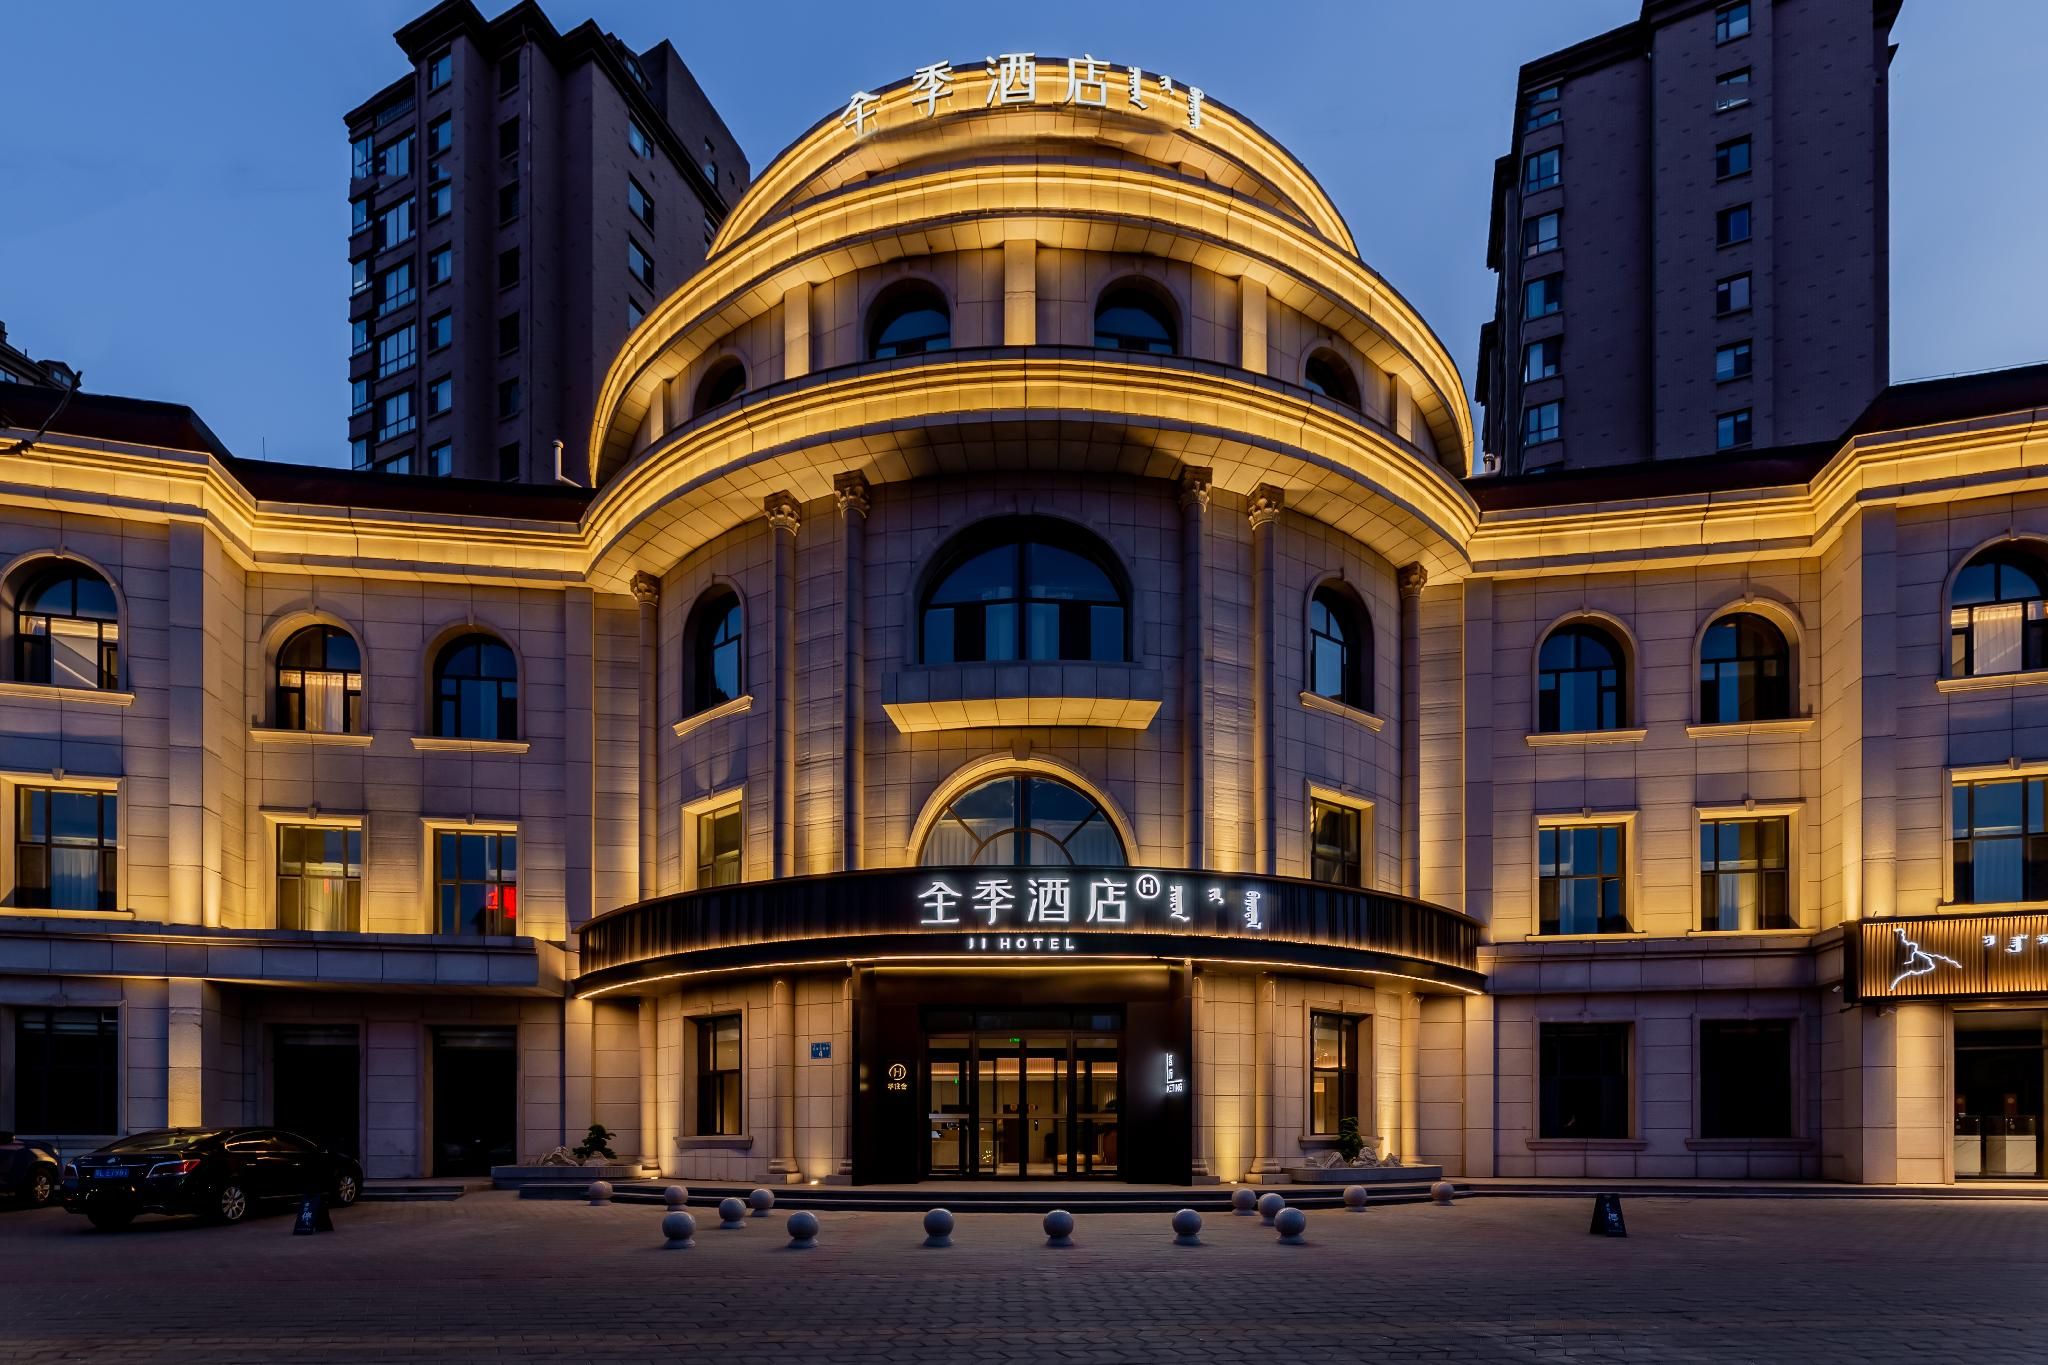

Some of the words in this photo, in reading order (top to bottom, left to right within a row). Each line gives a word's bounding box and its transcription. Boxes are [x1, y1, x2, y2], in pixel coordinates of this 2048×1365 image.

[841, 52, 1110, 135] 全季酒店
[918, 878, 1128, 925] 全季酒店
[969, 938, 986, 950] JI
[1000, 938, 1075, 950] HOTEL
